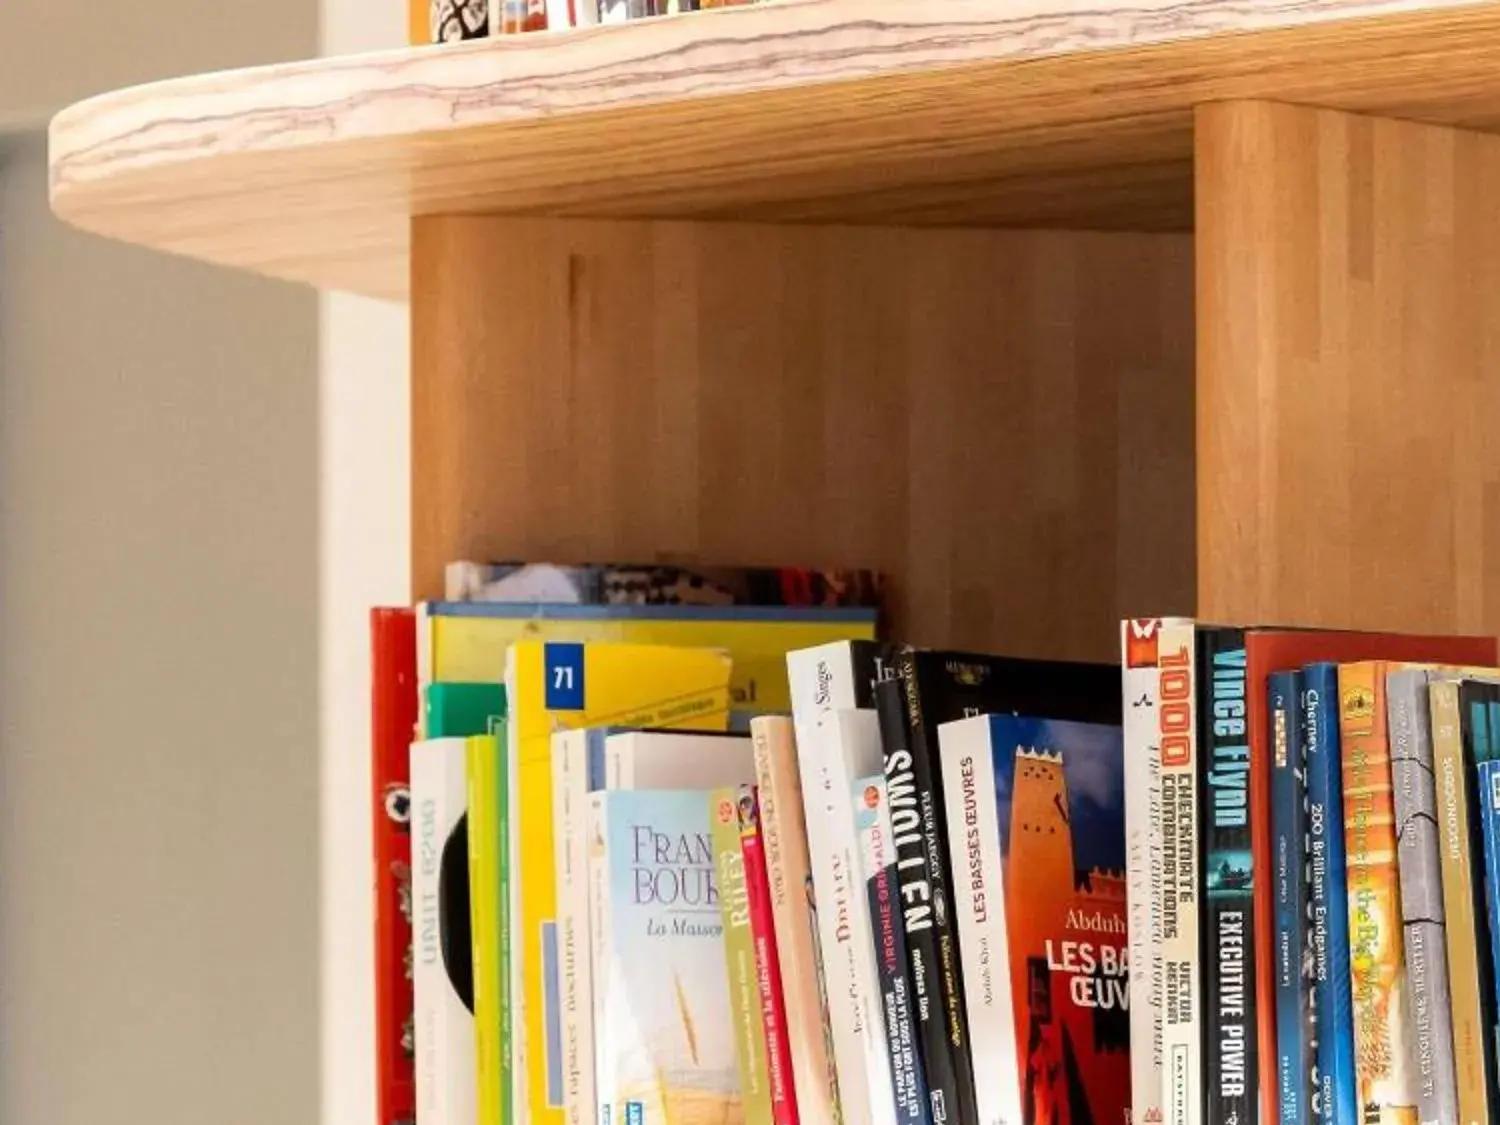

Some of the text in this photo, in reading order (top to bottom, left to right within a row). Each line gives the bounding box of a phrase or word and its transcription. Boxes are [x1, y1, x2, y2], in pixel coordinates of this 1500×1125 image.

[553, 666, 574, 689] 71
[1160, 646, 1190, 767] 1000
[1208, 649, 1249, 826] Vince Flynn
[1306, 689, 1320, 752] Chernev
[884, 749, 933, 932] SWOLLEN
[960, 757, 987, 923] LES BASSES ŒUVRES
[1161, 773, 1177, 939] COMBINATIONS
[1178, 773, 1194, 903] CHECKMATE
[729, 851, 749, 928] RILEY
[1311, 803, 1328, 981] 200 Brilliant Endgames
[419, 893, 438, 965] UNIT
[647, 917, 667, 936] La
[882, 904, 897, 974] VIRGINIE
[1045, 939, 1096, 972] LES
[896, 1005, 907, 1019] LA
[912, 949, 929, 1020] melissa lion
[1167, 962, 1177, 1024] HENKIN
[1180, 961, 1191, 1023] VICTOR
[1220, 912, 1244, 1096] EXECUTIVE POWER
[1323, 1076, 1332, 1118] DOVER
